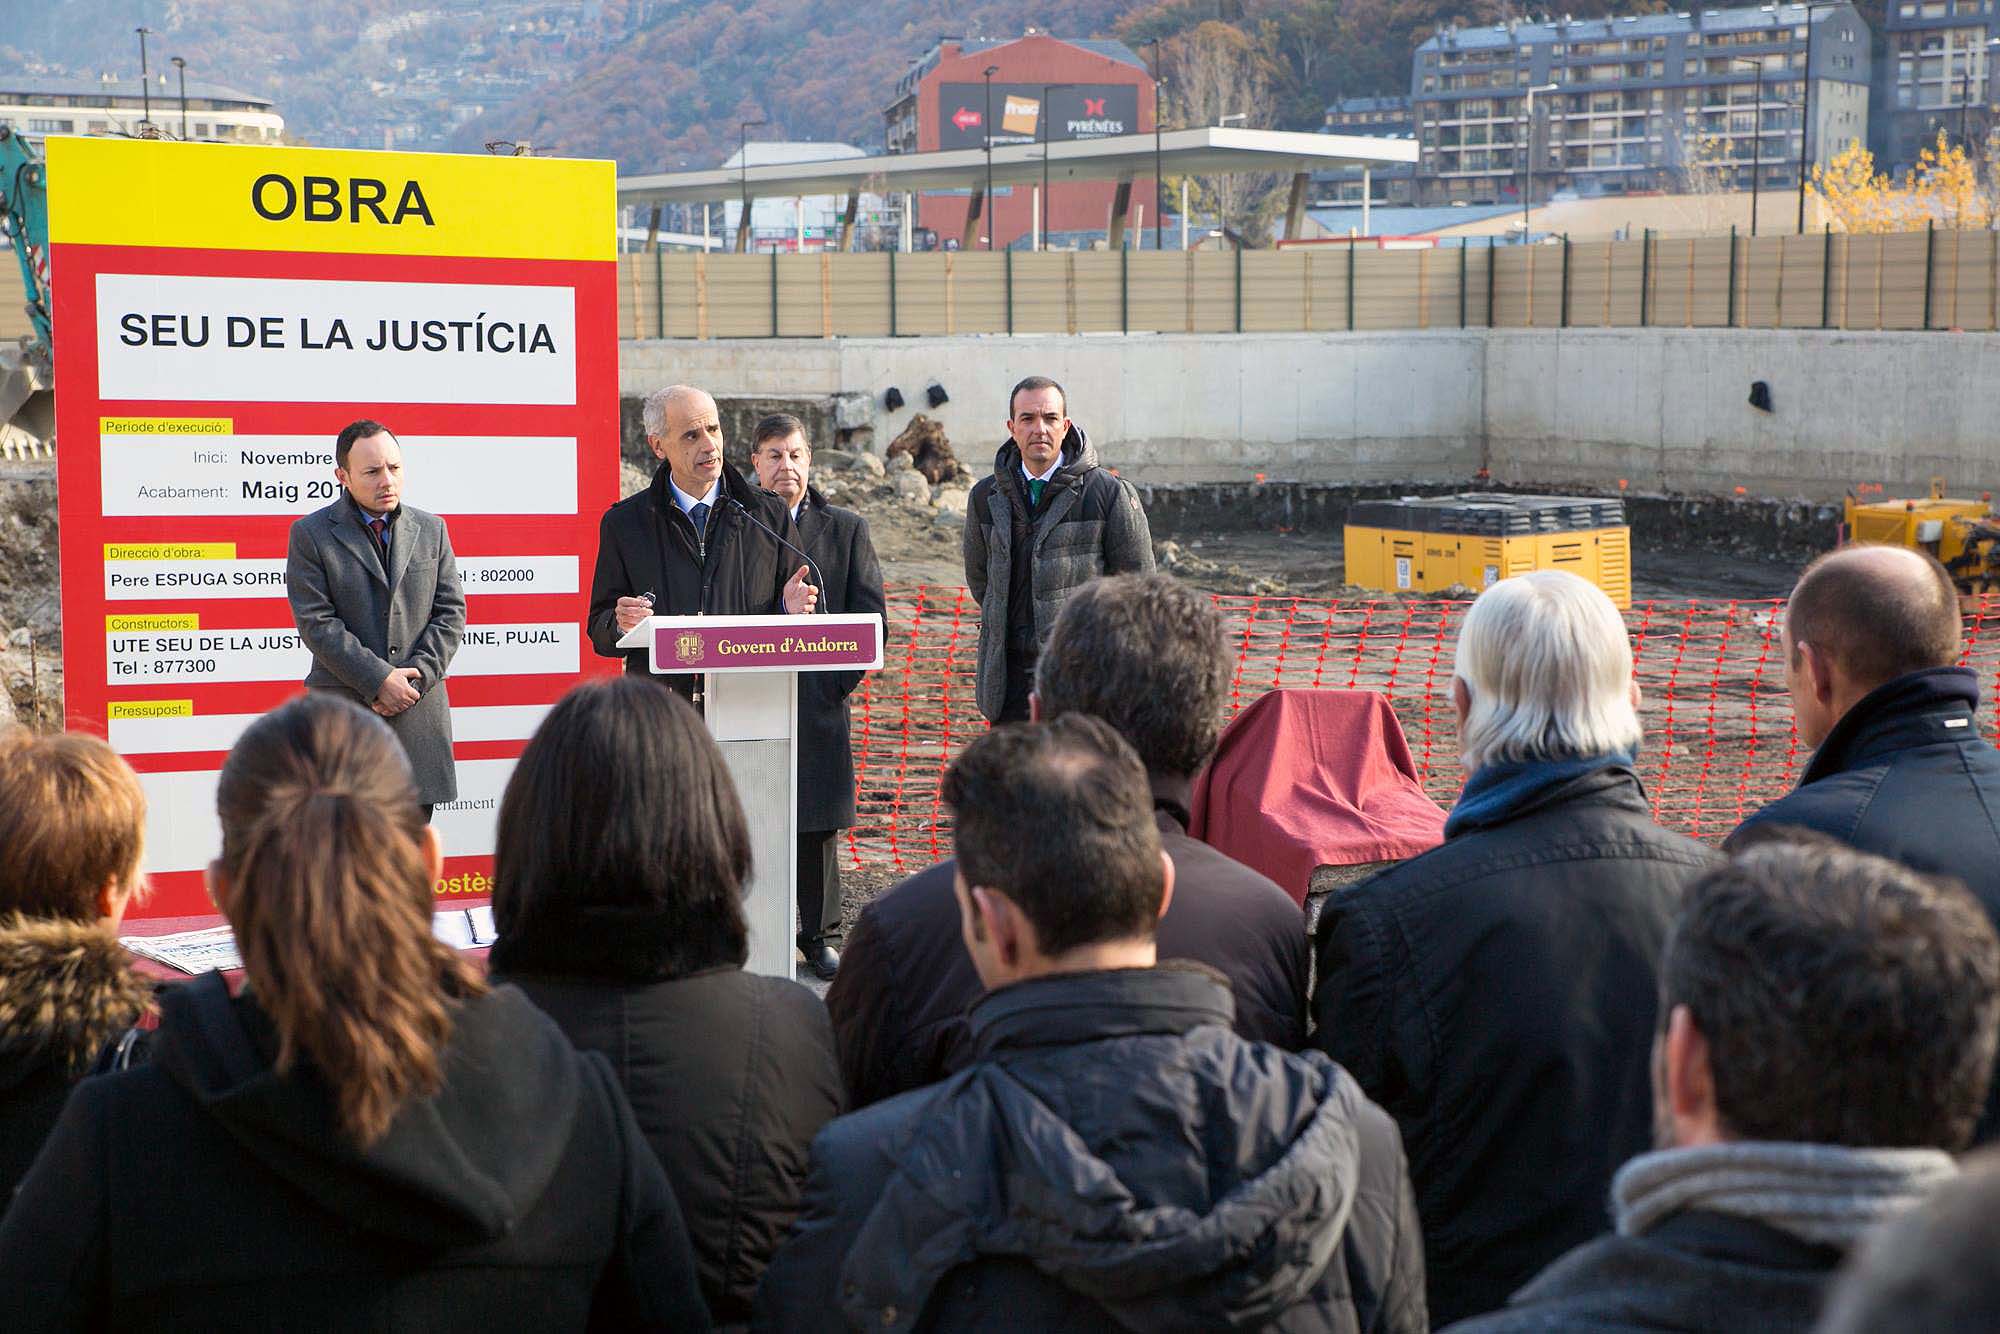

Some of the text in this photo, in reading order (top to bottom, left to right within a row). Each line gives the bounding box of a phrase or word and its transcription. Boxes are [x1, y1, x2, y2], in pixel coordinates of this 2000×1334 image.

[252, 174, 435, 226] OBRA
[120, 312, 556, 353] SEU DE LA JUSTÍCIA
[193, 450, 332, 465] Inici: Novembre
[138, 481, 343, 503] Acabament: Maig 201
[110, 547, 205, 559] Direcció d'obra:
[111, 574, 149, 587] Pere
[155, 573, 228, 587] ESPUGA
[233, 572, 287, 586] SORRI
[480, 569, 534, 582] 802000
[112, 618, 193, 630] Constructors:
[113, 639, 150, 653] UTE
[156, 638, 193, 652] SEU
[200, 637, 224, 651] DE
[230, 637, 253, 650] LA
[258, 636, 301, 650] JUST
[506, 631, 559, 644] PUJAL
[718, 636, 858, 654] Govern d'Andorra
[113, 661, 137, 675] Tel
[154, 660, 216, 674] 877300
[113, 704, 186, 718] Pressupost:
[434, 798, 495, 811] enament
[433, 872, 497, 894] ostès
